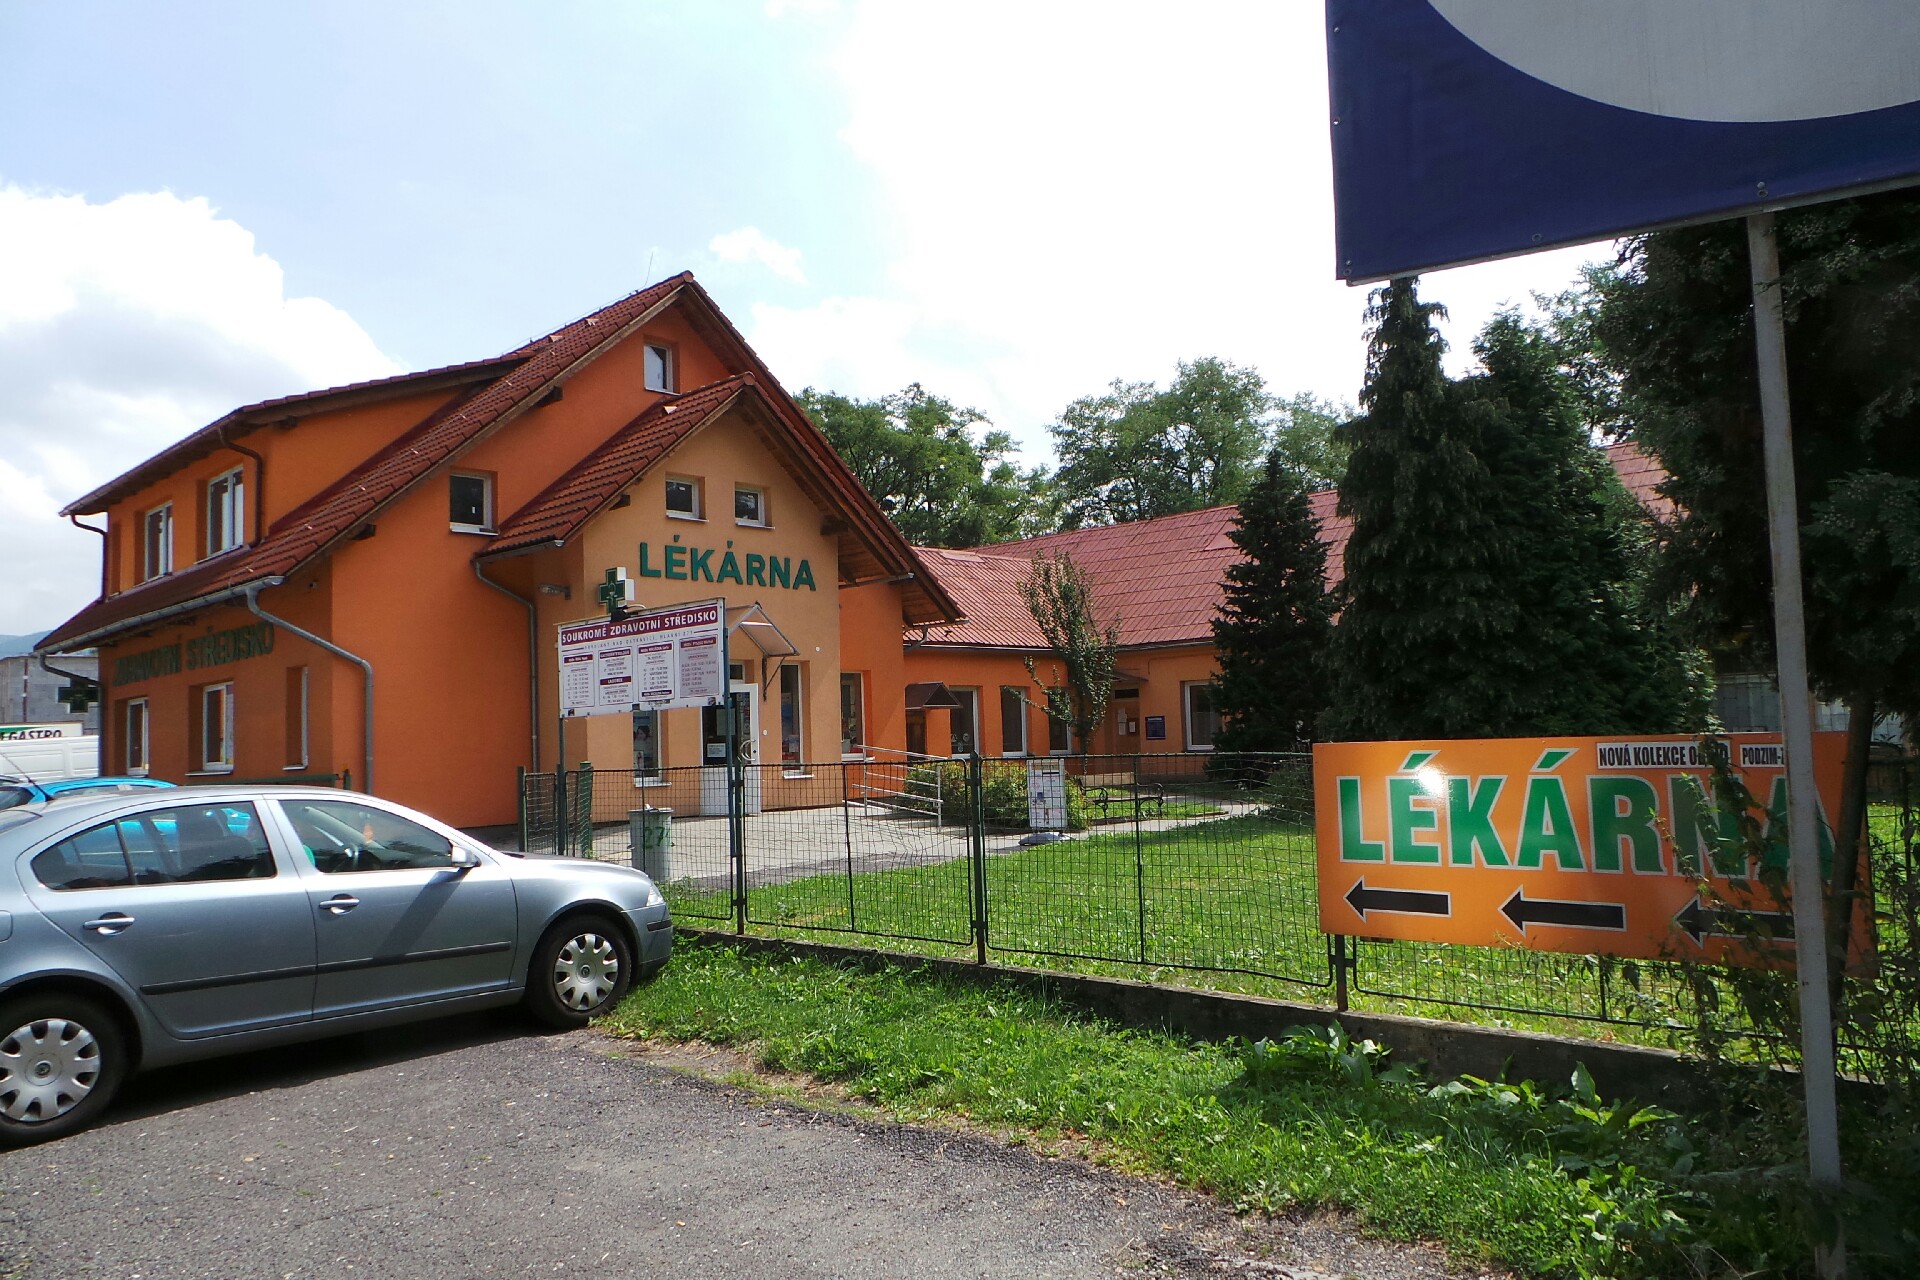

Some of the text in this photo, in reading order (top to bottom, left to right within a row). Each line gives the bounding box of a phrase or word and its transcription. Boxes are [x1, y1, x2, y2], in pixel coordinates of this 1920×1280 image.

[640, 535, 816, 591] LÉKÁRNA
[186, 621, 275, 670] STŘEDISKO
[562, 610, 717, 643] SOUKROMÉ ZDRAVOTNÍ STŘEDISKO
[1599, 743, 1631, 767] NOVÁ
[1634, 746, 1686, 766] KOLEKCE
